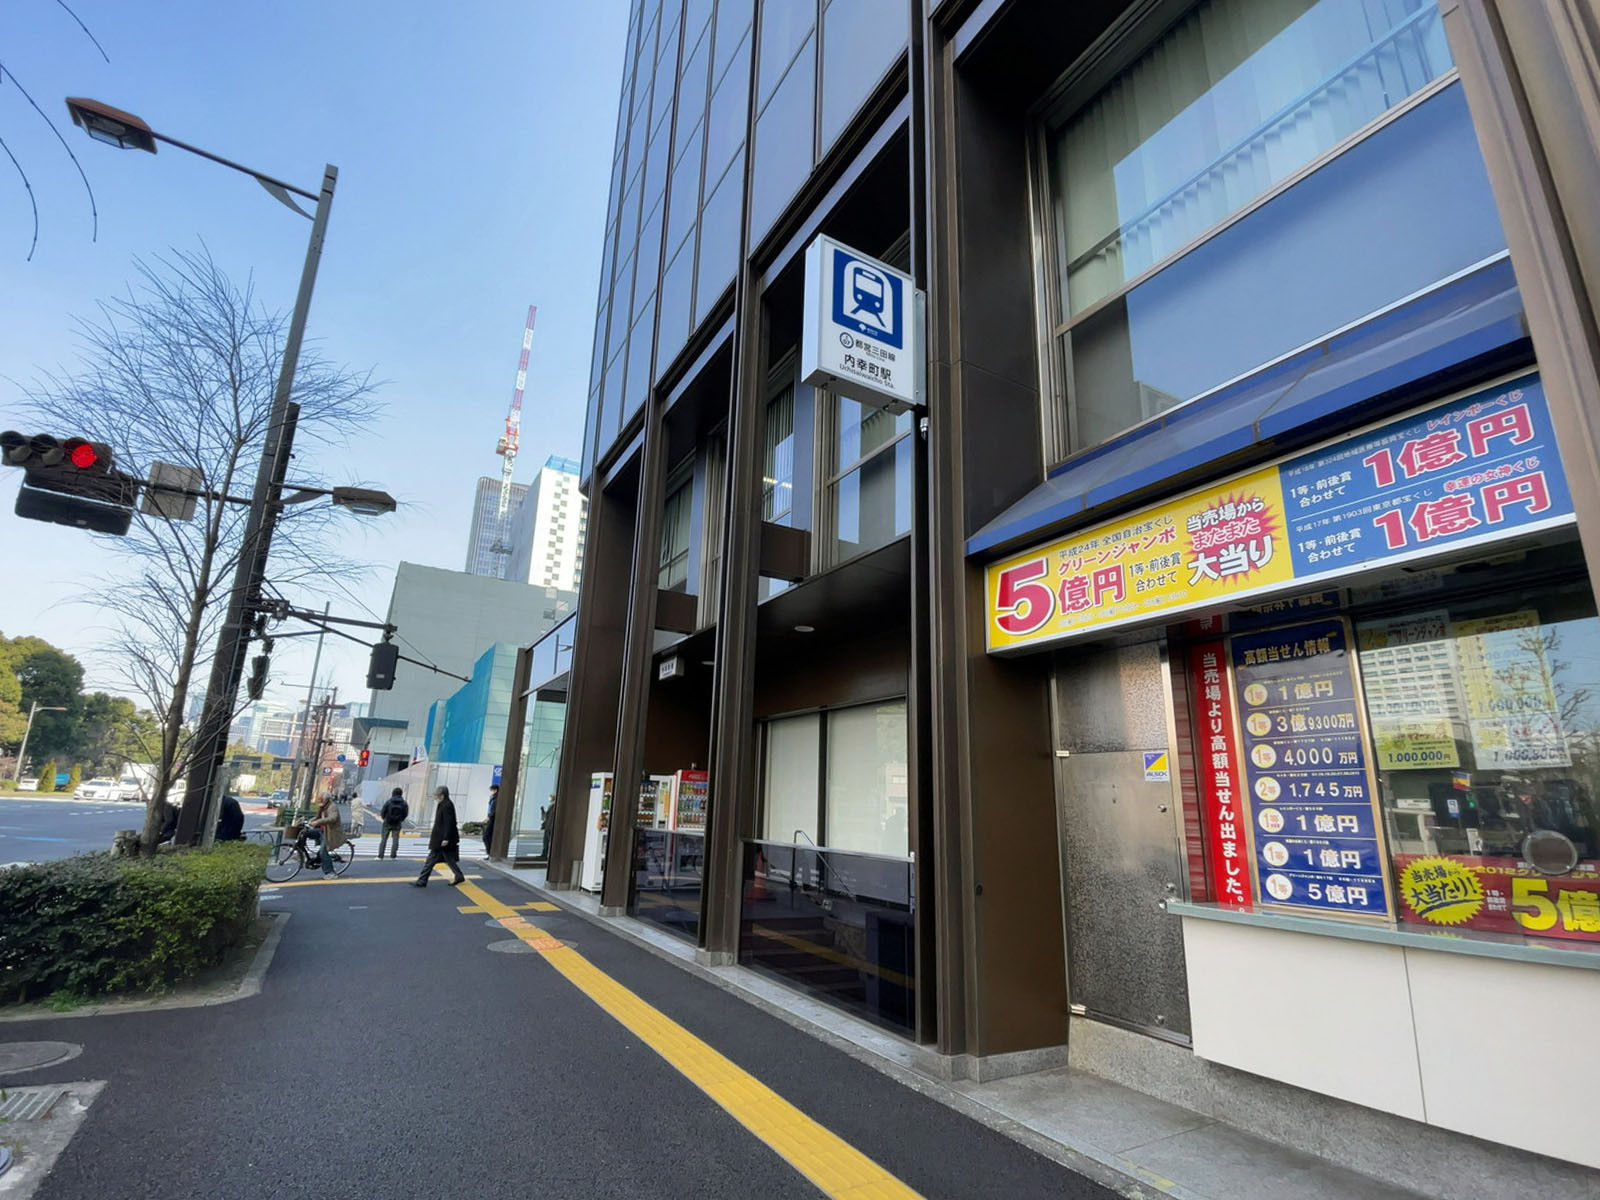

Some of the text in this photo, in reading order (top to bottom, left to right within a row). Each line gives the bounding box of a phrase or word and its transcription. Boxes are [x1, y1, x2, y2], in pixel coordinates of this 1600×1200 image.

[855, 339, 896, 362] 都営三田線
[844, 354, 892, 381] 内幸町駅
[1427, 389, 1524, 430] レインボーくじ
[1362, 403, 1535, 488] 1億円
[1443, 455, 1540, 493] 幸運の女神くじ
[1299, 485, 1346, 508] 合わせて
[1373, 470, 1551, 549] 1億円
[1187, 497, 1266, 533] 当売場から
[1059, 516, 1173, 559] 平成24年 全国自治宝くじ
[1192, 516, 1261, 550] またまた
[1058, 526, 1176, 576] グリーンジャンボ
[1187, 534, 1273, 587] 大当り
[1307, 543, 1356, 564] 合わせて
[1136, 570, 1177, 593] 合わせて
[1243, 637, 1331, 665] 高額当せん情報
[1278, 680, 1333, 700] 1億円
[1202, 652, 1244, 903] 当売場より高額当せん出ました。
[1296, 814, 1359, 833] 1億円
[1303, 848, 1361, 870] 1億円
[1307, 882, 1368, 906] 5億円
